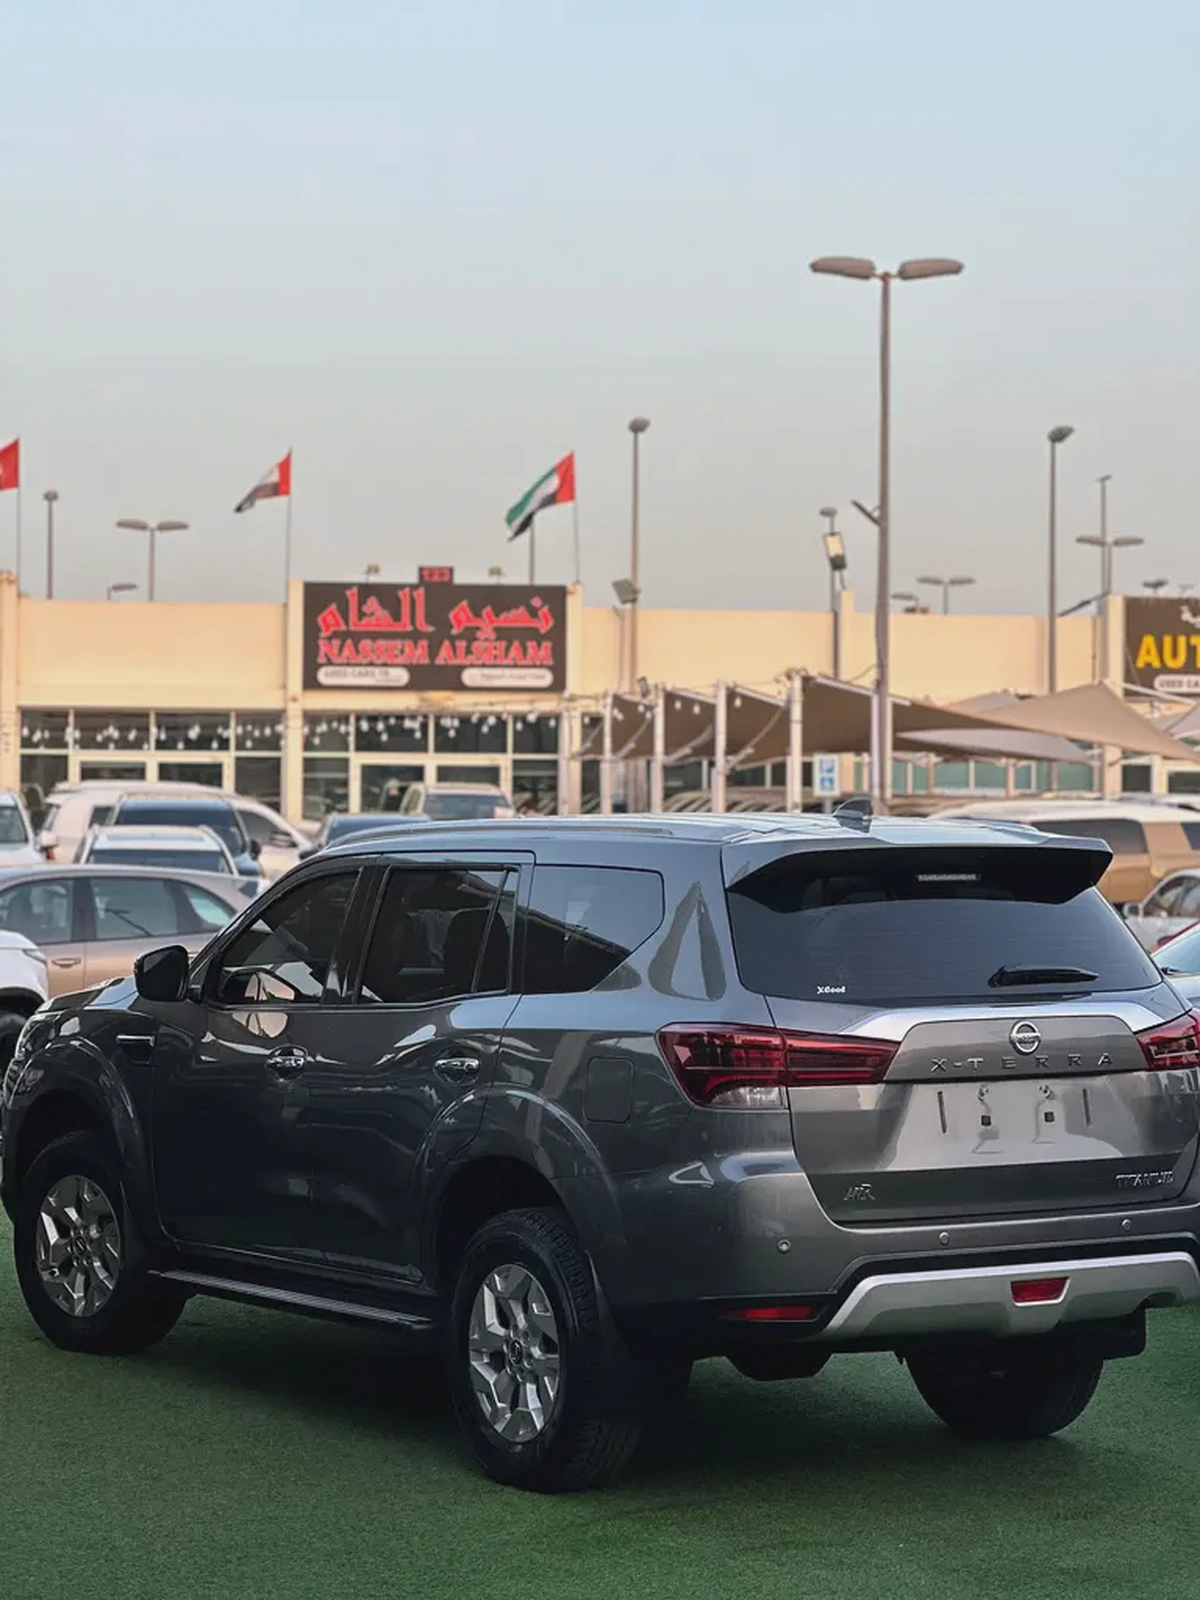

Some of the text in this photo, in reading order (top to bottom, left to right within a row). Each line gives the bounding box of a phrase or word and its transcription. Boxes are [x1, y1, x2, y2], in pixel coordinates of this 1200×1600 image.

[316, 638, 554, 666] NASSEM ALSHAM
[930, 1052, 1113, 1073] X-TERRA
